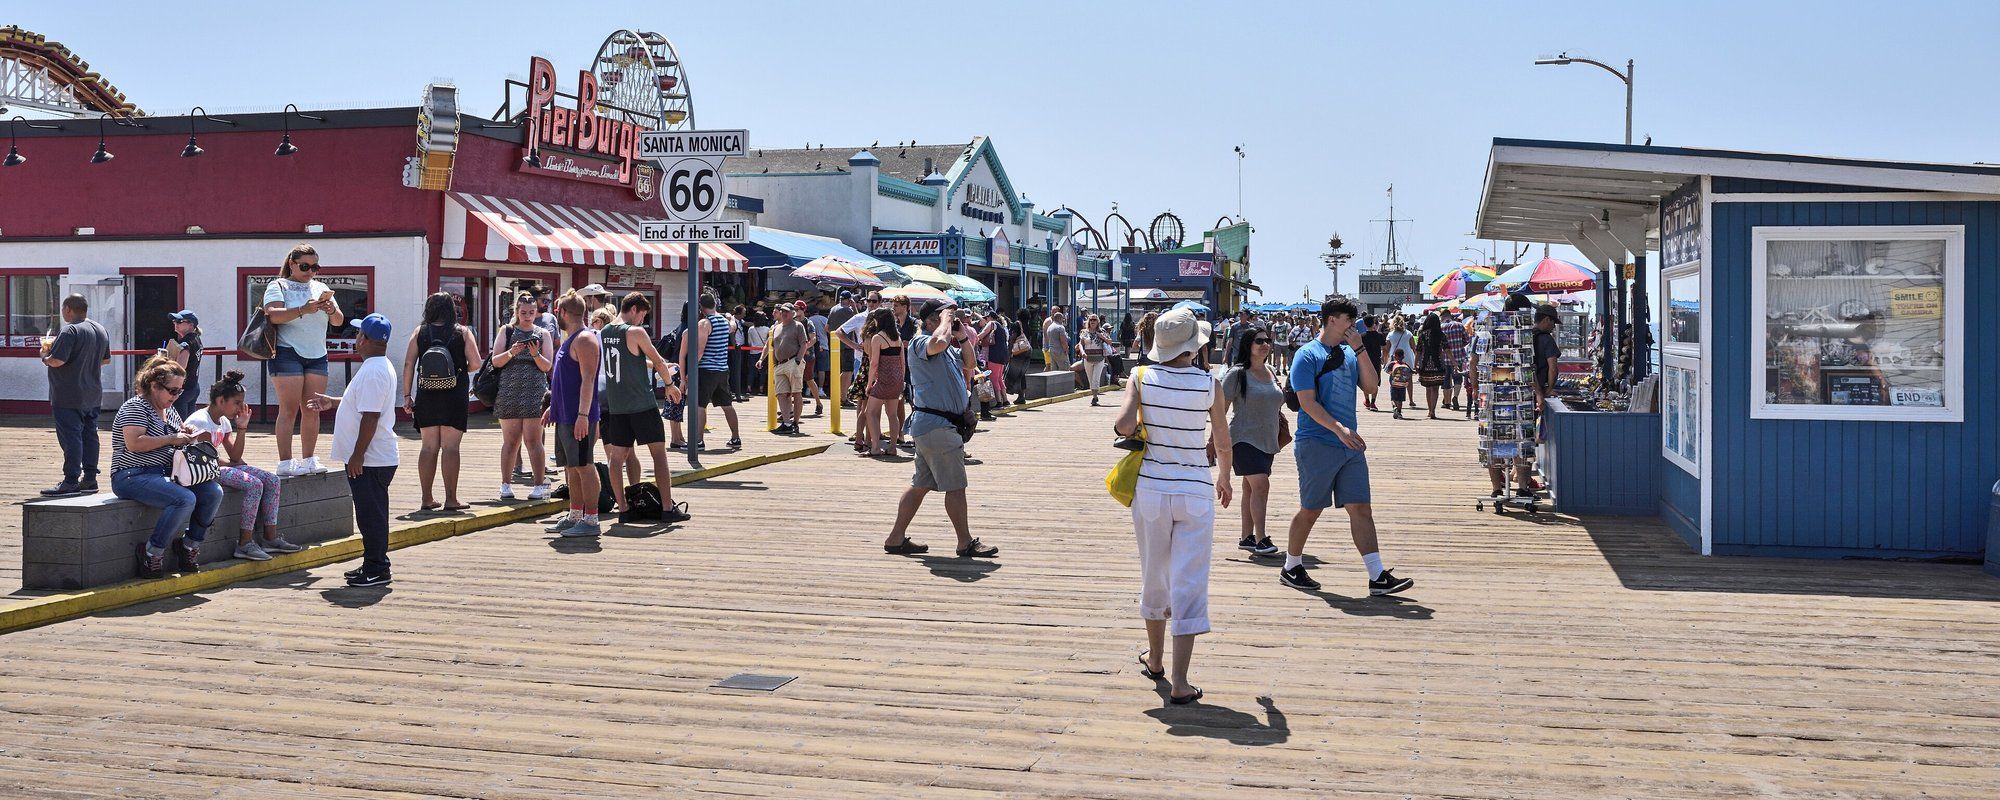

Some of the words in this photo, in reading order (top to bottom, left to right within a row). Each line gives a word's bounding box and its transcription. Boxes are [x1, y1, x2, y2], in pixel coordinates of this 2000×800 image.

[643, 136, 684, 153] SANTA
[688, 135, 741, 152] MONICA
[638, 176, 652, 193] 66
[669, 168, 715, 213] 66
[645, 225, 668, 239] End
[672, 225, 686, 239] of
[689, 225, 709, 239] the
[713, 224, 740, 239] Trail
[875, 240, 939, 250] PLAYLAND
[1538, 280, 1584, 289] CHURROS
[1895, 293, 1924, 301] SMILE
[603, 337, 621, 345] STAFF
[1896, 392, 1921, 402] END
